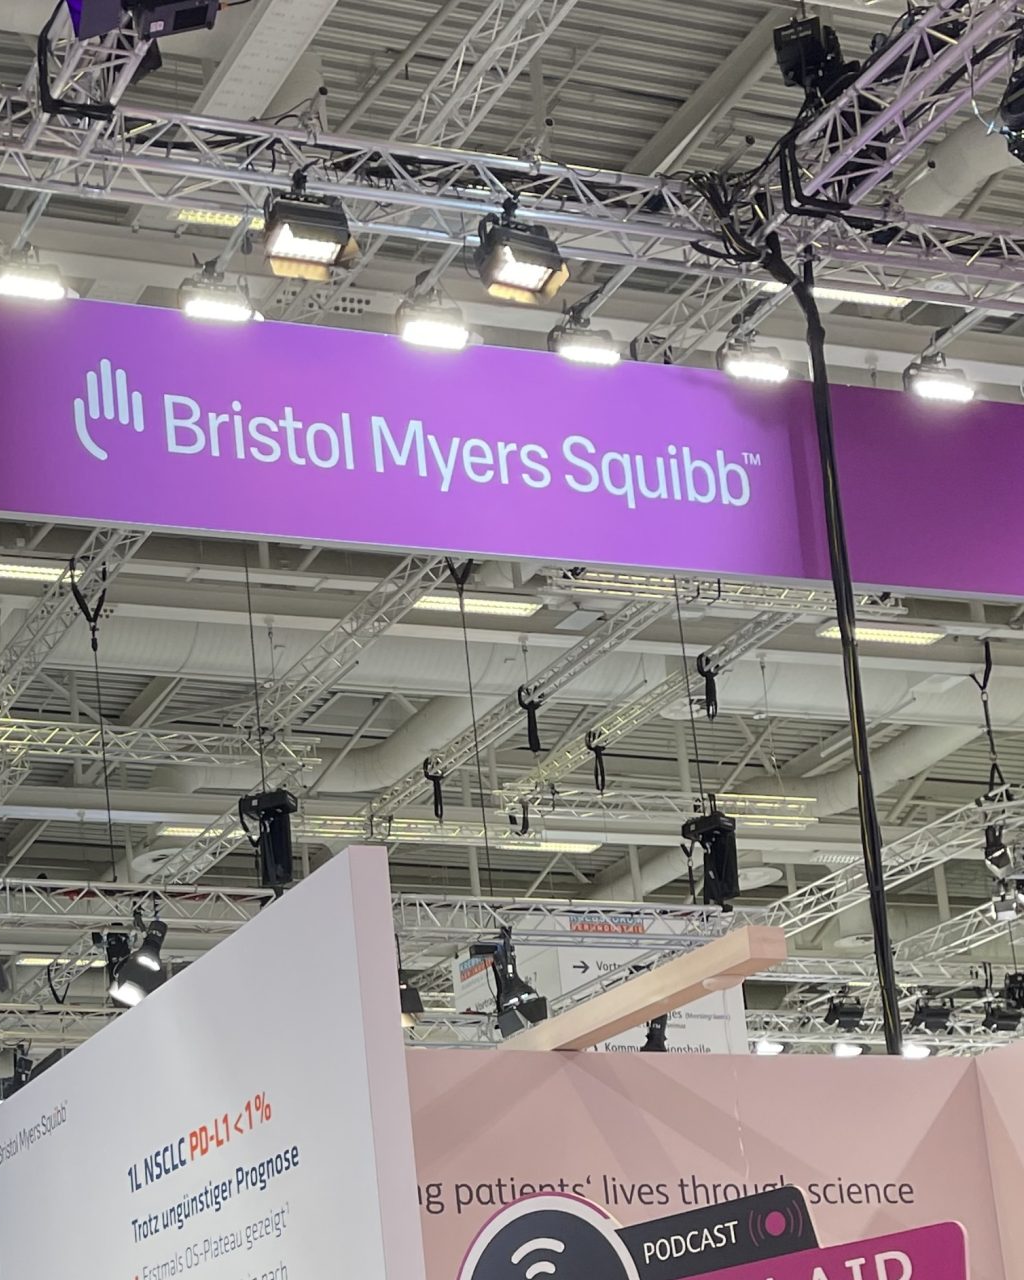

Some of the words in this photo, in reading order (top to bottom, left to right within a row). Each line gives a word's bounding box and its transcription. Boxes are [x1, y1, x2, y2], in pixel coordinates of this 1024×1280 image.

[163, 393, 355, 471] Bristol
[371, 416, 552, 492] Myers
[19, 1123, 41, 1151] Myers
[127, 1164, 142, 1194] 1L
[144, 1137, 187, 1185] NSCLC
[131, 1213, 160, 1243] Trotz
[162, 1178, 233, 1230] ungünstiger
[235, 1145, 299, 1195] Prognose
[602, 1174, 669, 1205] lives
[809, 1177, 914, 1205] science
[185, 1230, 243, 1270] OS-Plateau
[643, 1220, 739, 1264] PODCAST
